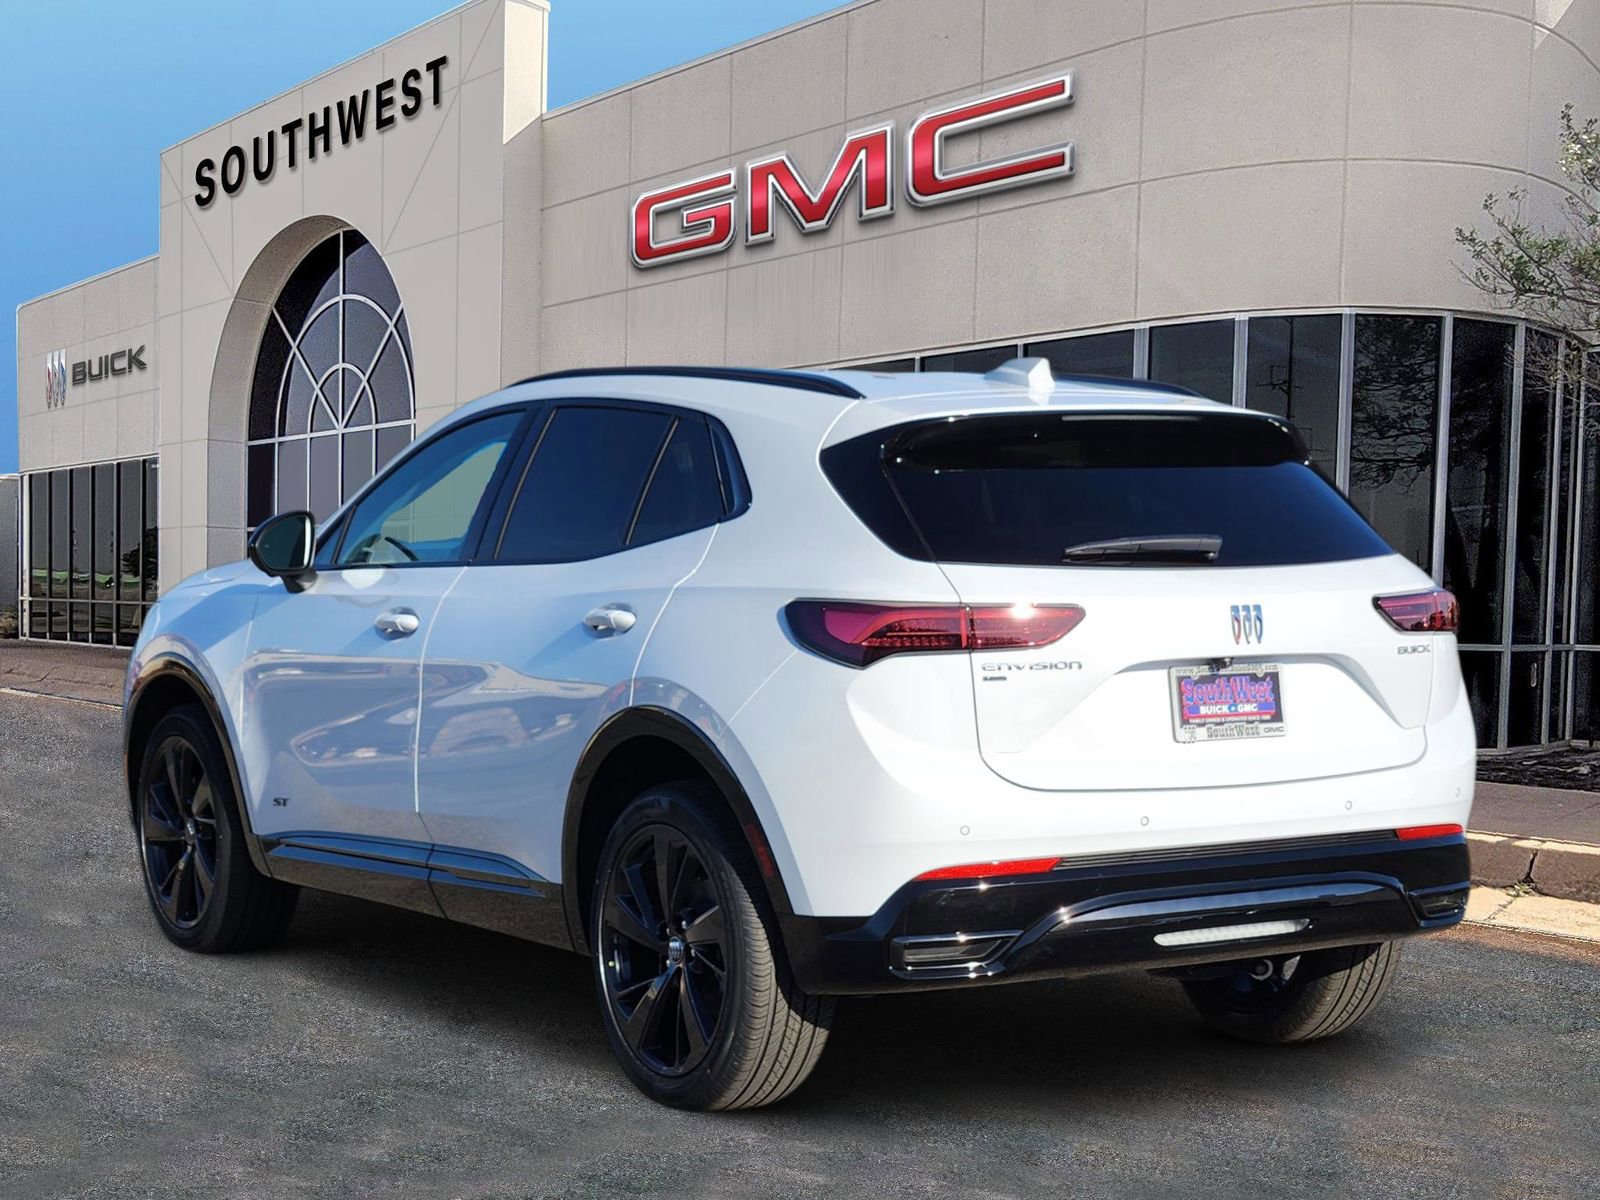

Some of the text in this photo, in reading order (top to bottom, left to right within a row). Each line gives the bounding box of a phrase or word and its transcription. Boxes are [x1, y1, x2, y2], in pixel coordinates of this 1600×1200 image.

[194, 55, 448, 208] SOUTHWEST
[630, 68, 1077, 269] GMC
[72, 344, 147, 386] BUICK
[1397, 644, 1431, 655] BUICK
[982, 661, 1082, 671] ENVISION
[1200, 702, 1258, 714] BUICK GMC
[272, 797, 290, 807] ST
